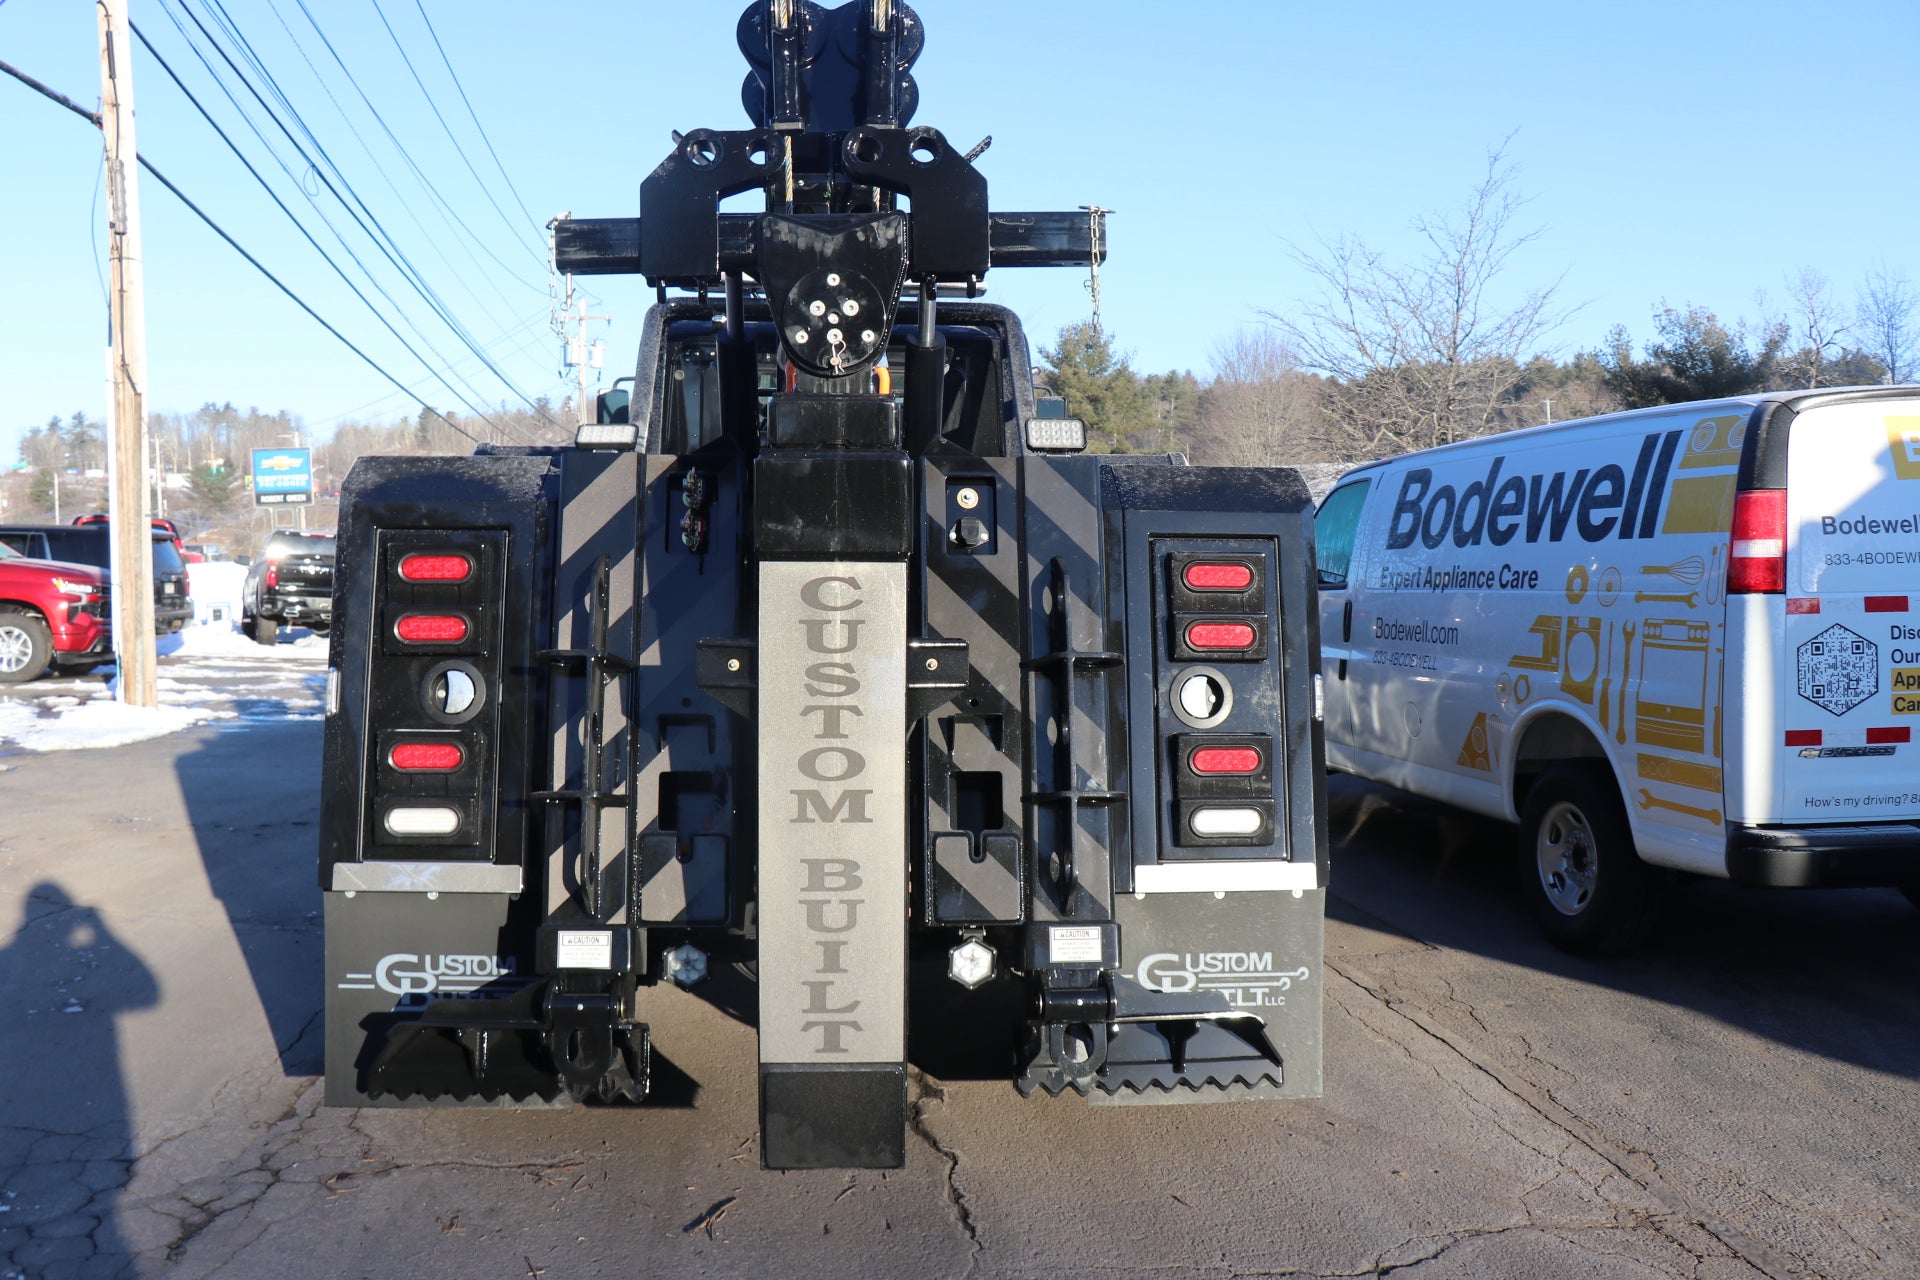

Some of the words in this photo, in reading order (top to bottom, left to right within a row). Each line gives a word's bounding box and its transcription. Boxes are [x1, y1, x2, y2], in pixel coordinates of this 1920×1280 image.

[1386, 430, 1684, 550] Bodewell
[1821, 514, 1920, 535] Bodewel
[1824, 552, 1920, 566] 833-4BODEW
[1380, 566, 1422, 590] Expert
[1423, 565, 1494, 593] Appliance
[1499, 564, 1538, 589] Care
[1375, 617, 1459, 645] Bodewell.com
[1373, 650, 1437, 670] 833-4BODEWELL
[790, 576, 873, 823] CUSTOM
[1805, 796, 1841, 807] How's
[1844, 797, 1861, 809] my
[1863, 794, 1909, 807] driving?
[573, 936, 600, 944] CAUTION
[1065, 930, 1090, 938] CAUTION
[799, 858, 865, 1053] BUILT
[1265, 996, 1285, 1006] LLC
